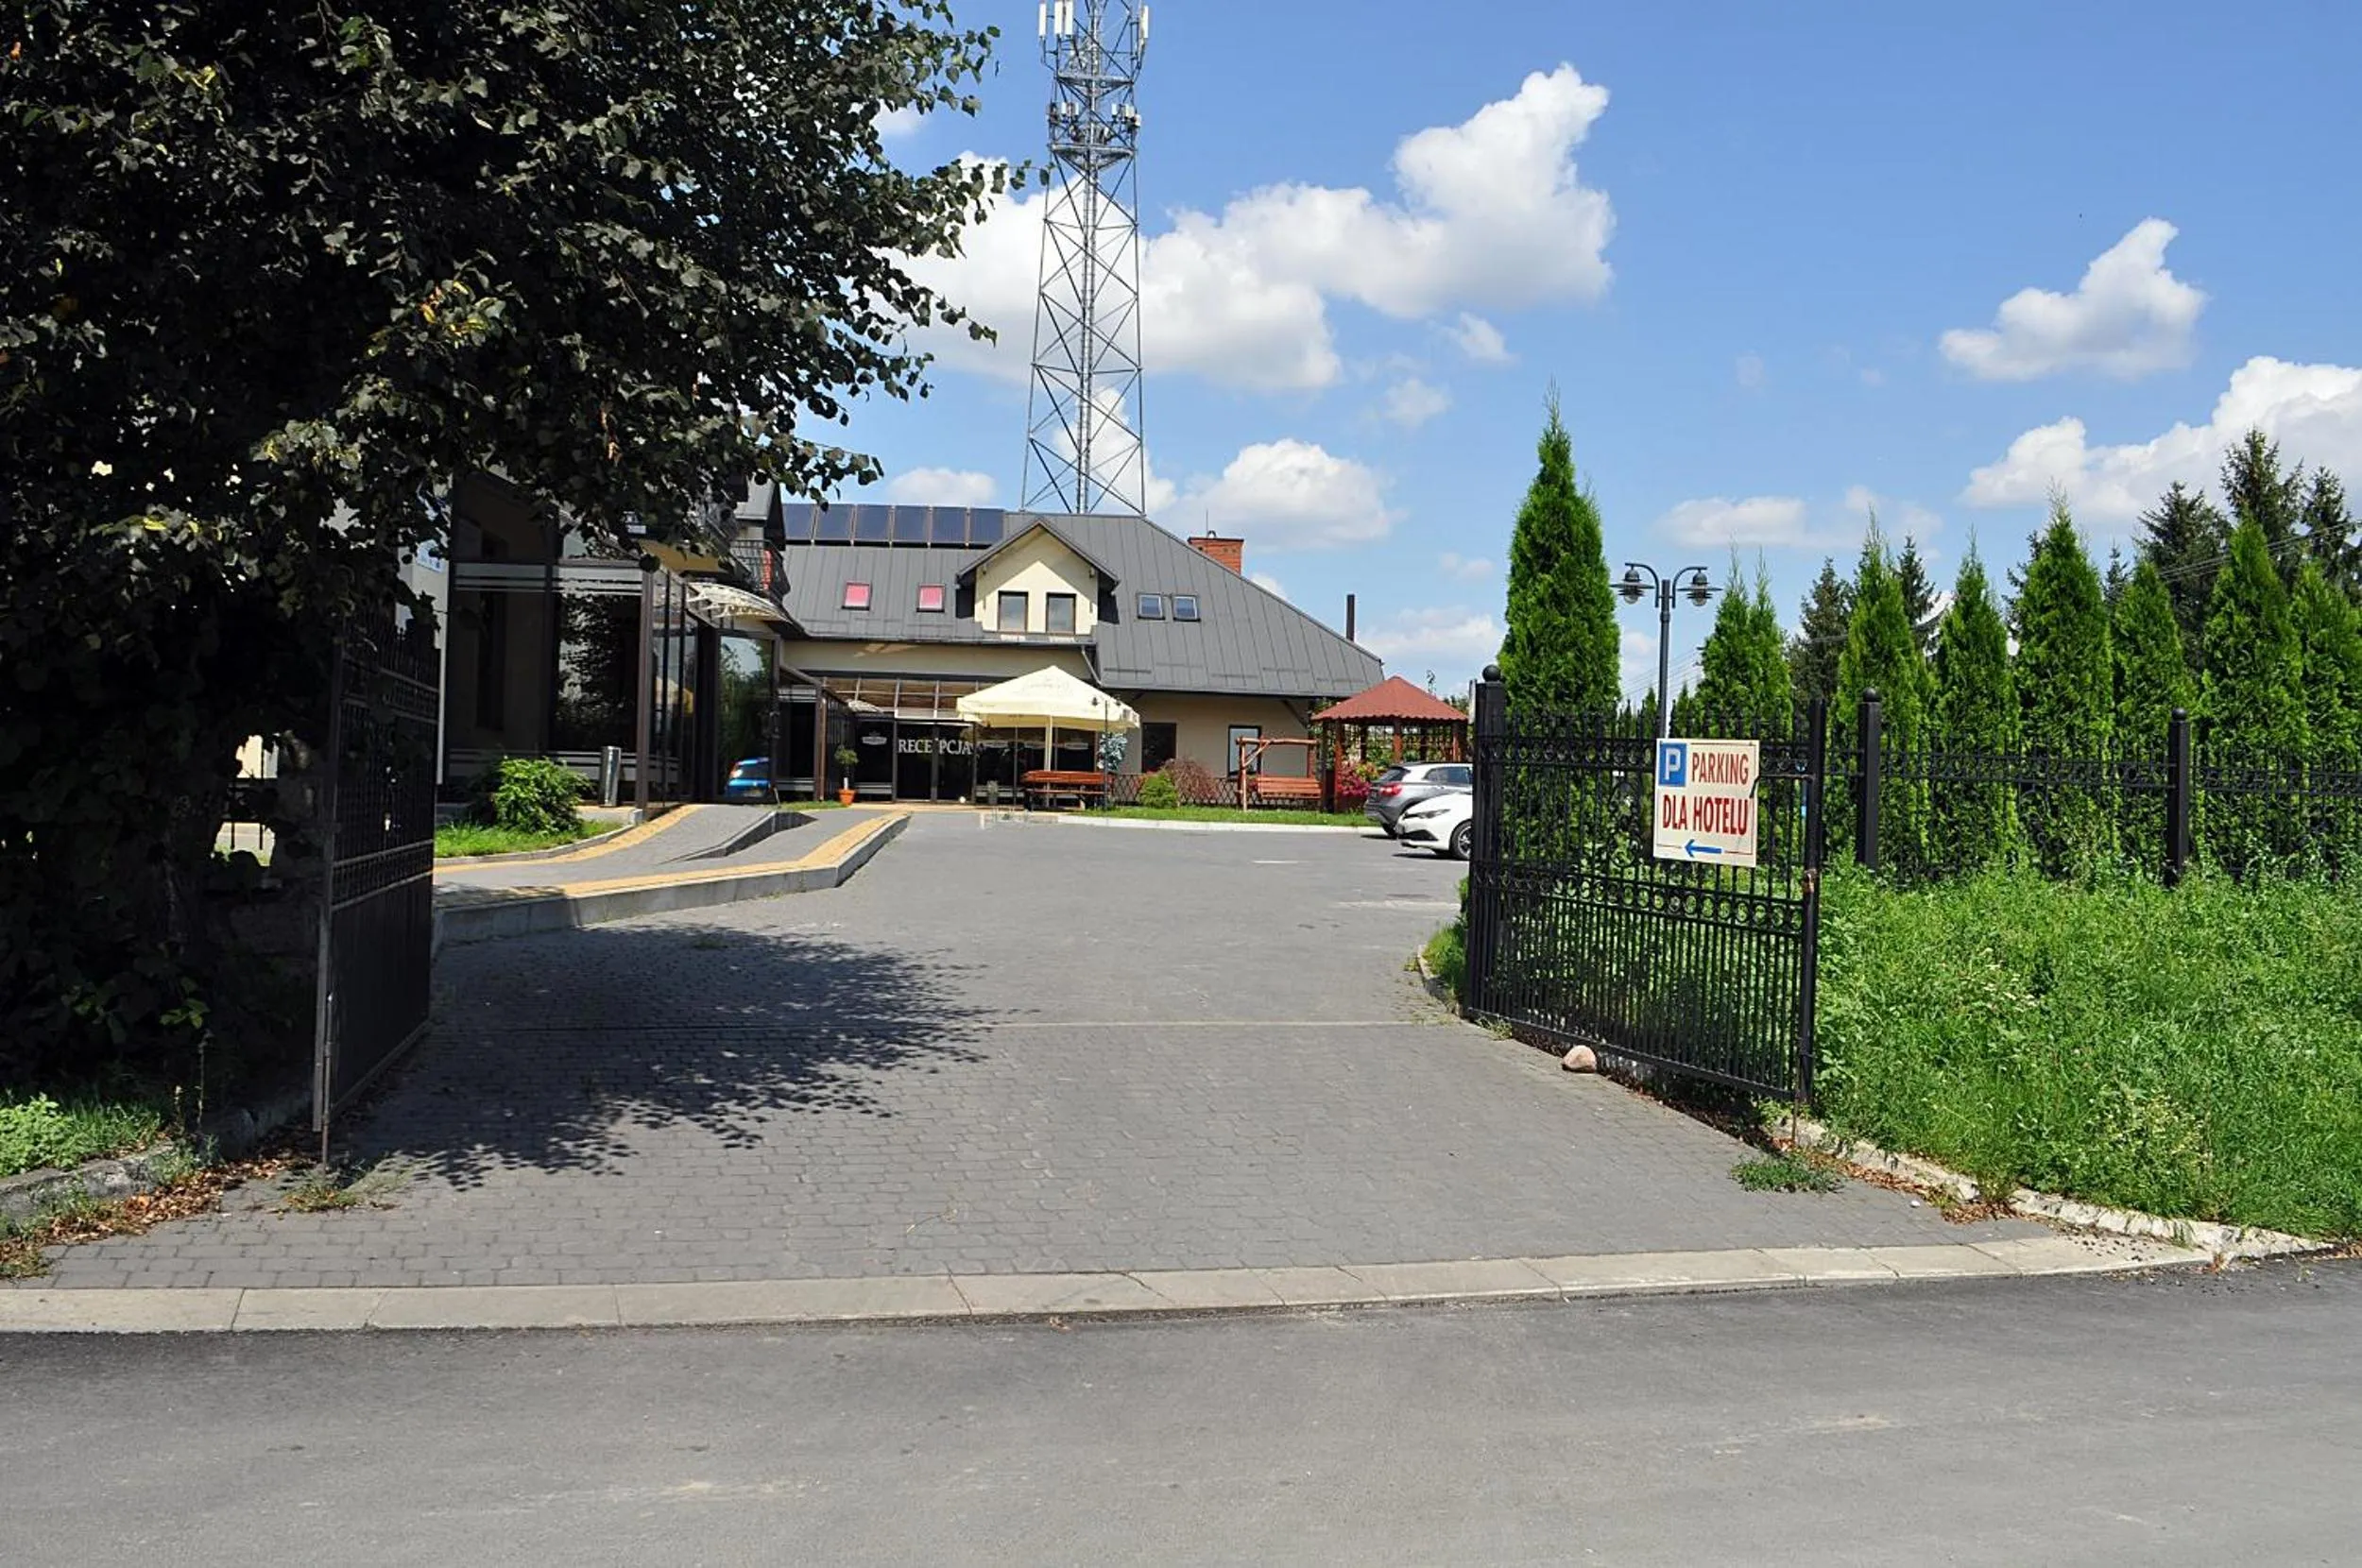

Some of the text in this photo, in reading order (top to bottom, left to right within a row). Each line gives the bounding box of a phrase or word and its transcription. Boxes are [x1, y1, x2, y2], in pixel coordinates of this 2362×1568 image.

[899, 739, 972, 755] RECEPCJA
[1664, 747, 1681, 780] P
[1692, 752, 1749, 785] PARKING
[1663, 794, 1748, 836] DLA HOTELU
